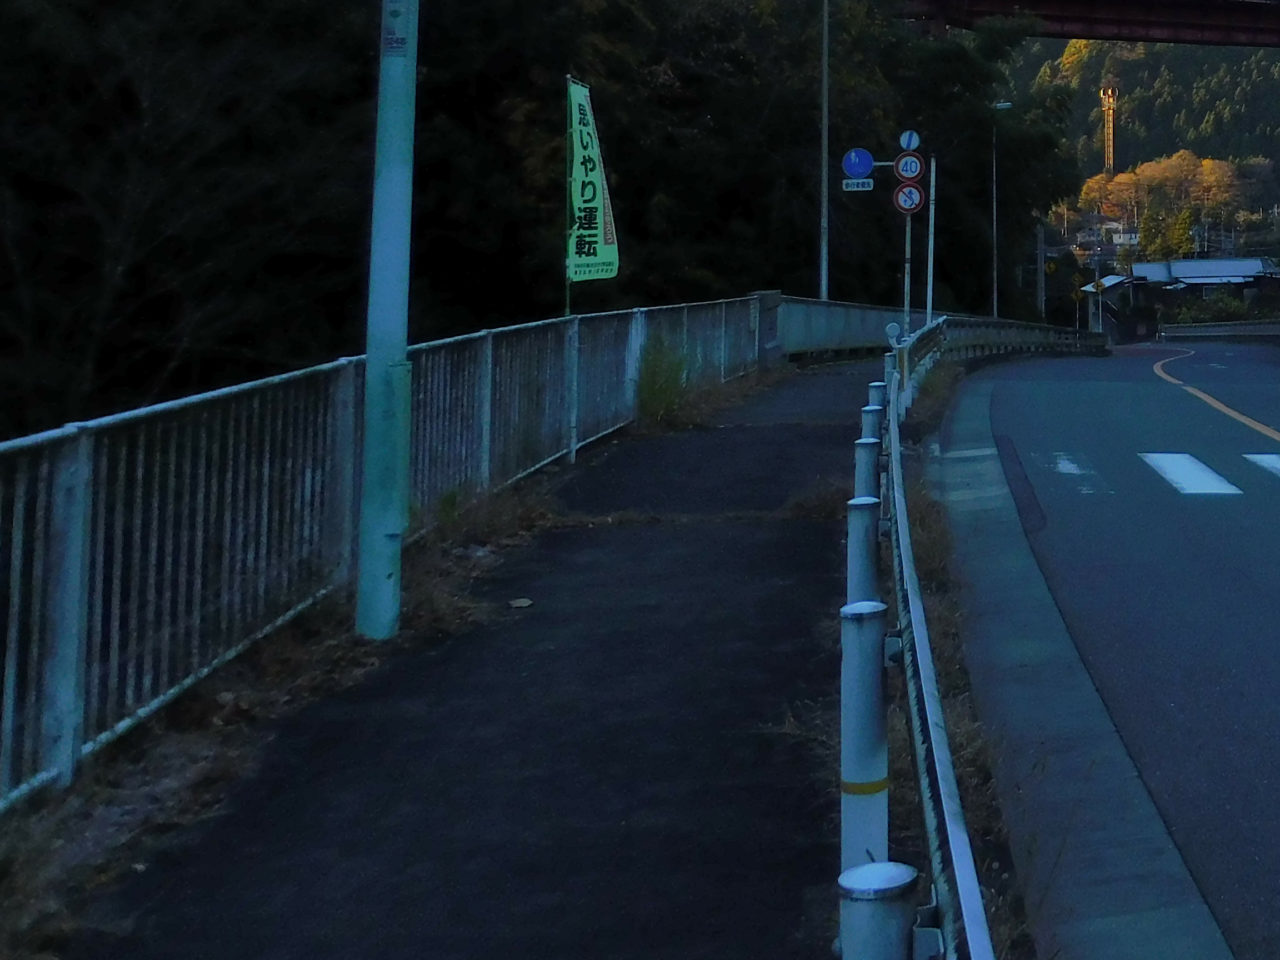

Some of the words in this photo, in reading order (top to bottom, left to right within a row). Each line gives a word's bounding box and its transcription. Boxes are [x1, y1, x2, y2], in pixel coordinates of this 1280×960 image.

[575, 103, 599, 258] 思いやり運転
[902, 160, 918, 174] 40
